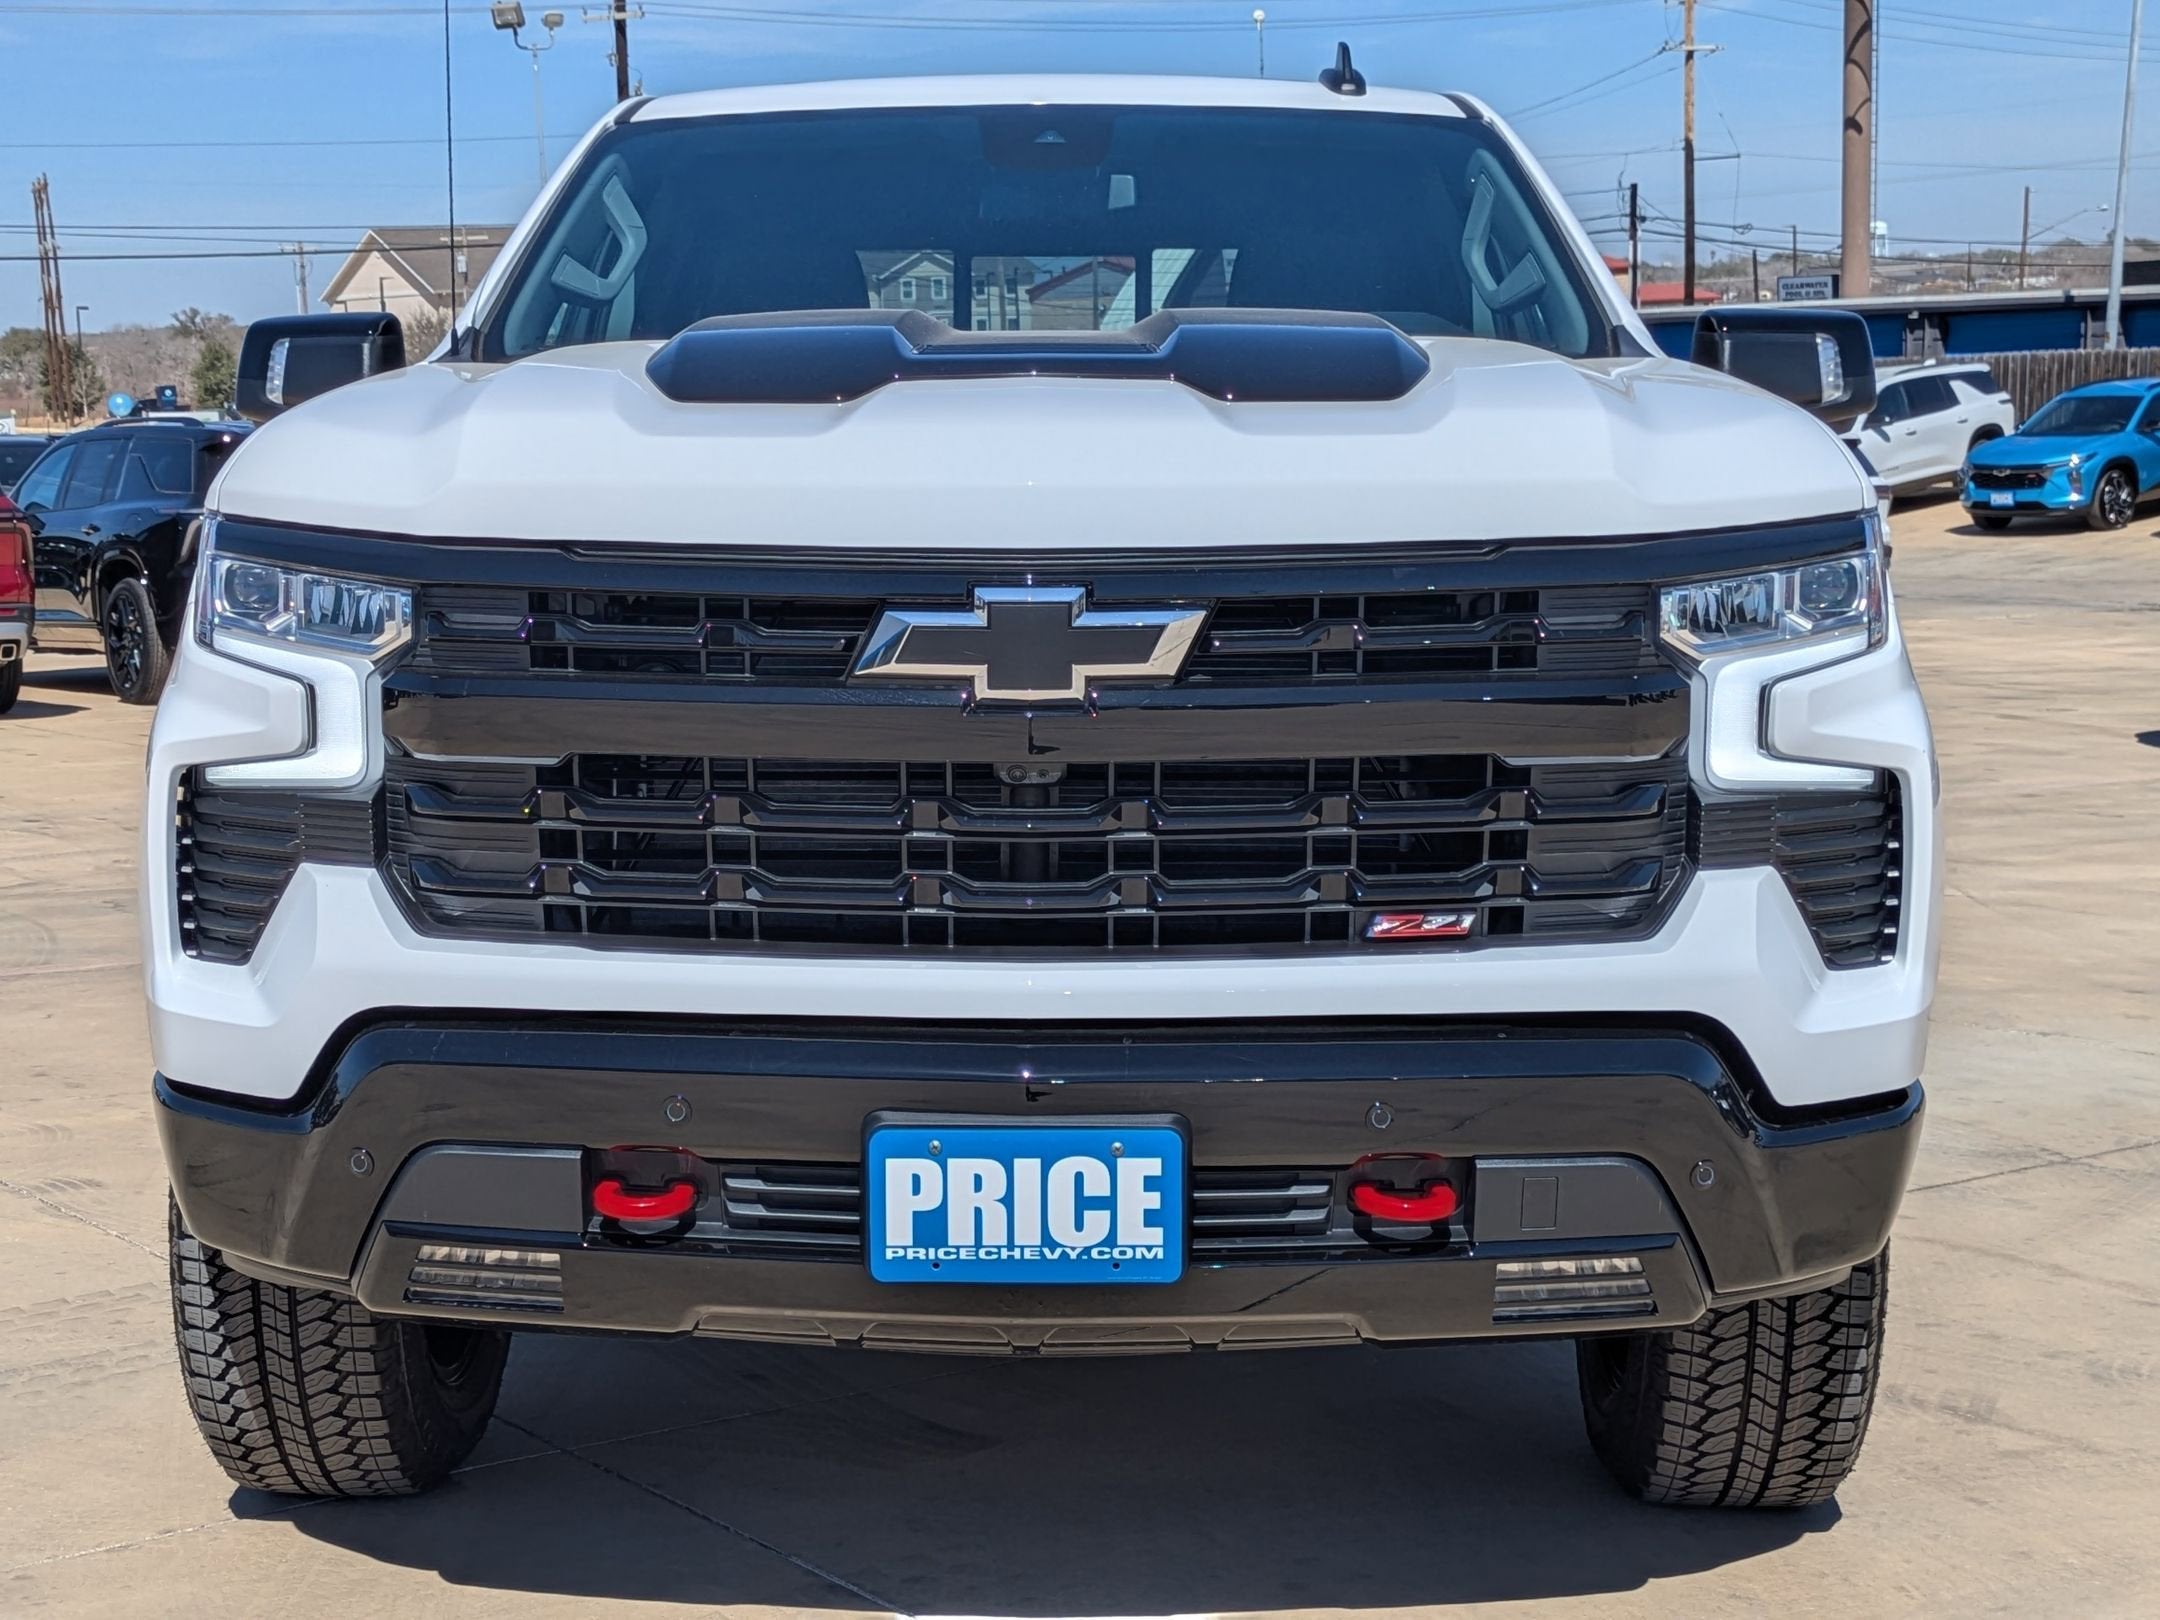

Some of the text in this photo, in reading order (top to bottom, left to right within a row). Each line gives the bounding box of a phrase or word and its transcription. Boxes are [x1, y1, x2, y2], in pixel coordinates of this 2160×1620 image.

[1781, 282, 1828, 290] CLEARWATER
[1366, 913, 1476, 938] Z71
[885, 1156, 1163, 1247] PRICE
[885, 1247, 1163, 1260] PRICECHEVY.COM
